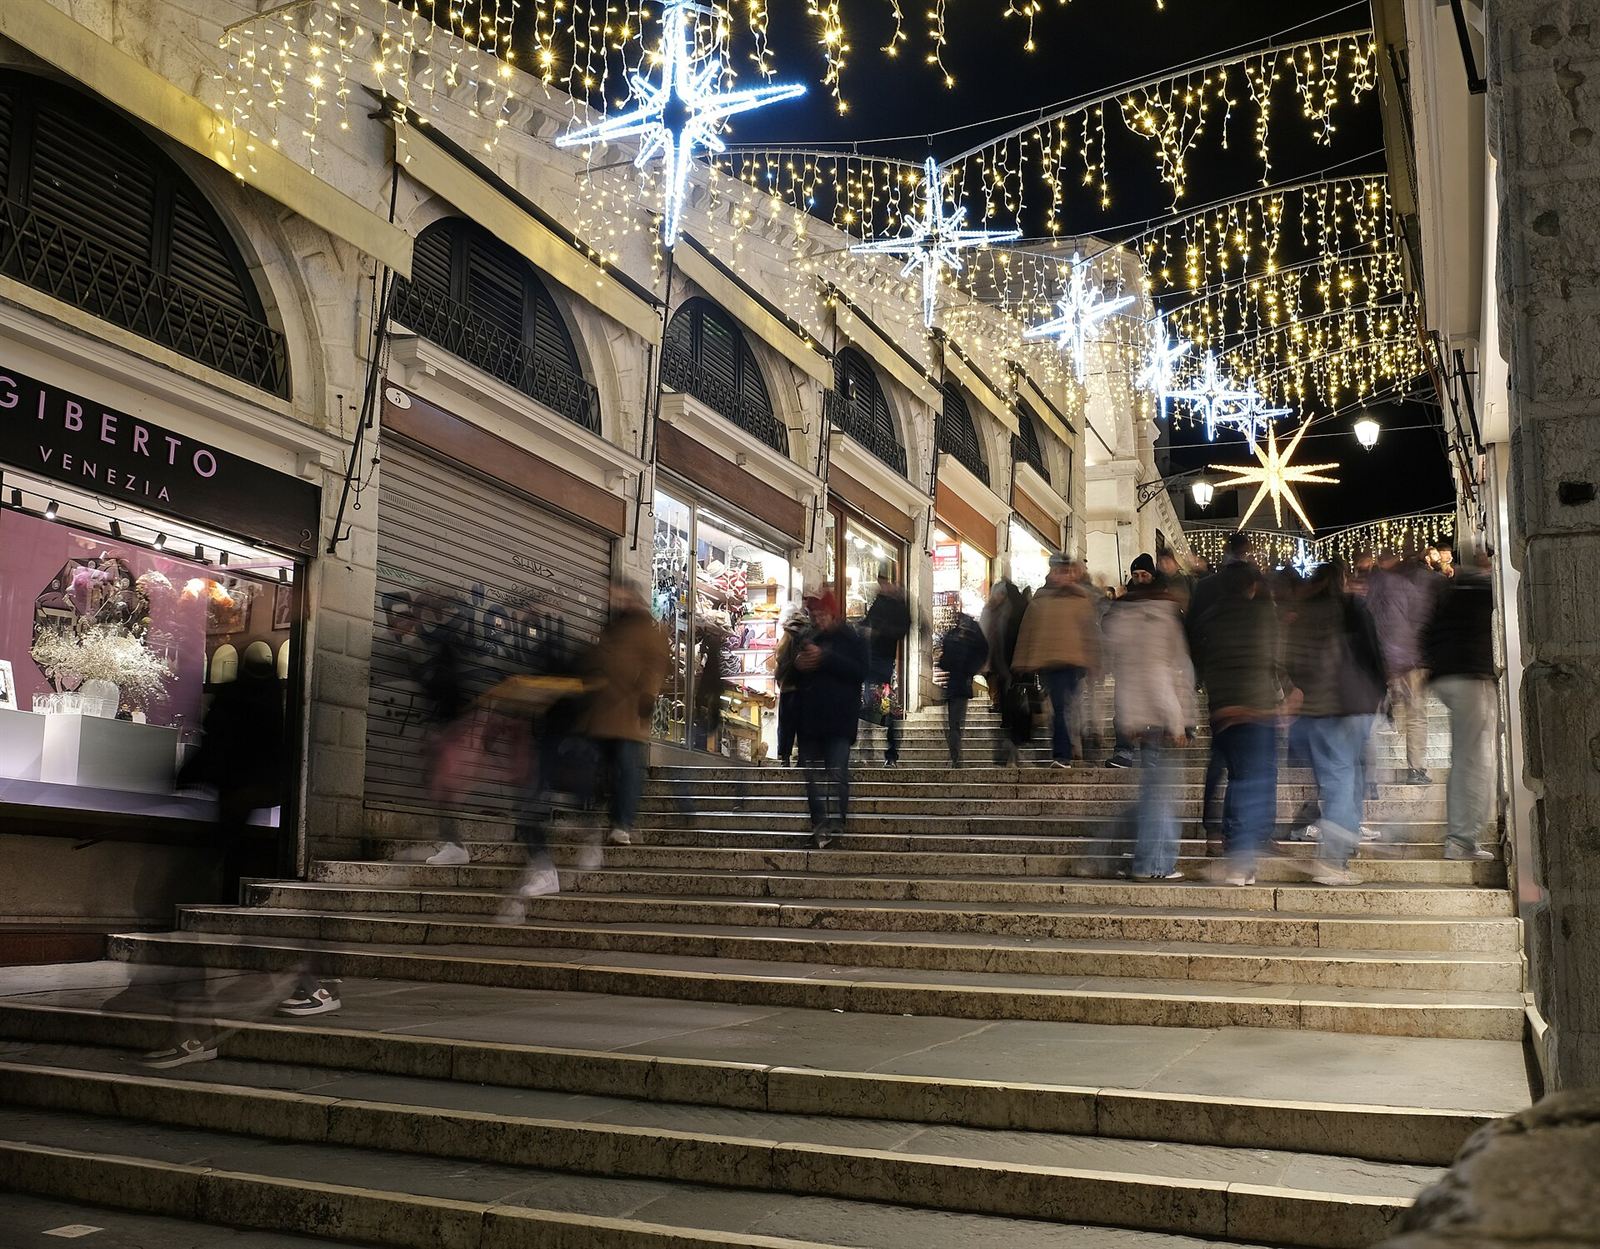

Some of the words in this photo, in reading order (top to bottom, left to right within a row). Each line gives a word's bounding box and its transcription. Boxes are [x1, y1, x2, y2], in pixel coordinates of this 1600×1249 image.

[0, 375, 218, 478] GIBERTO
[39, 446, 170, 502] VENEZIA
[300, 528, 312, 550] 2
